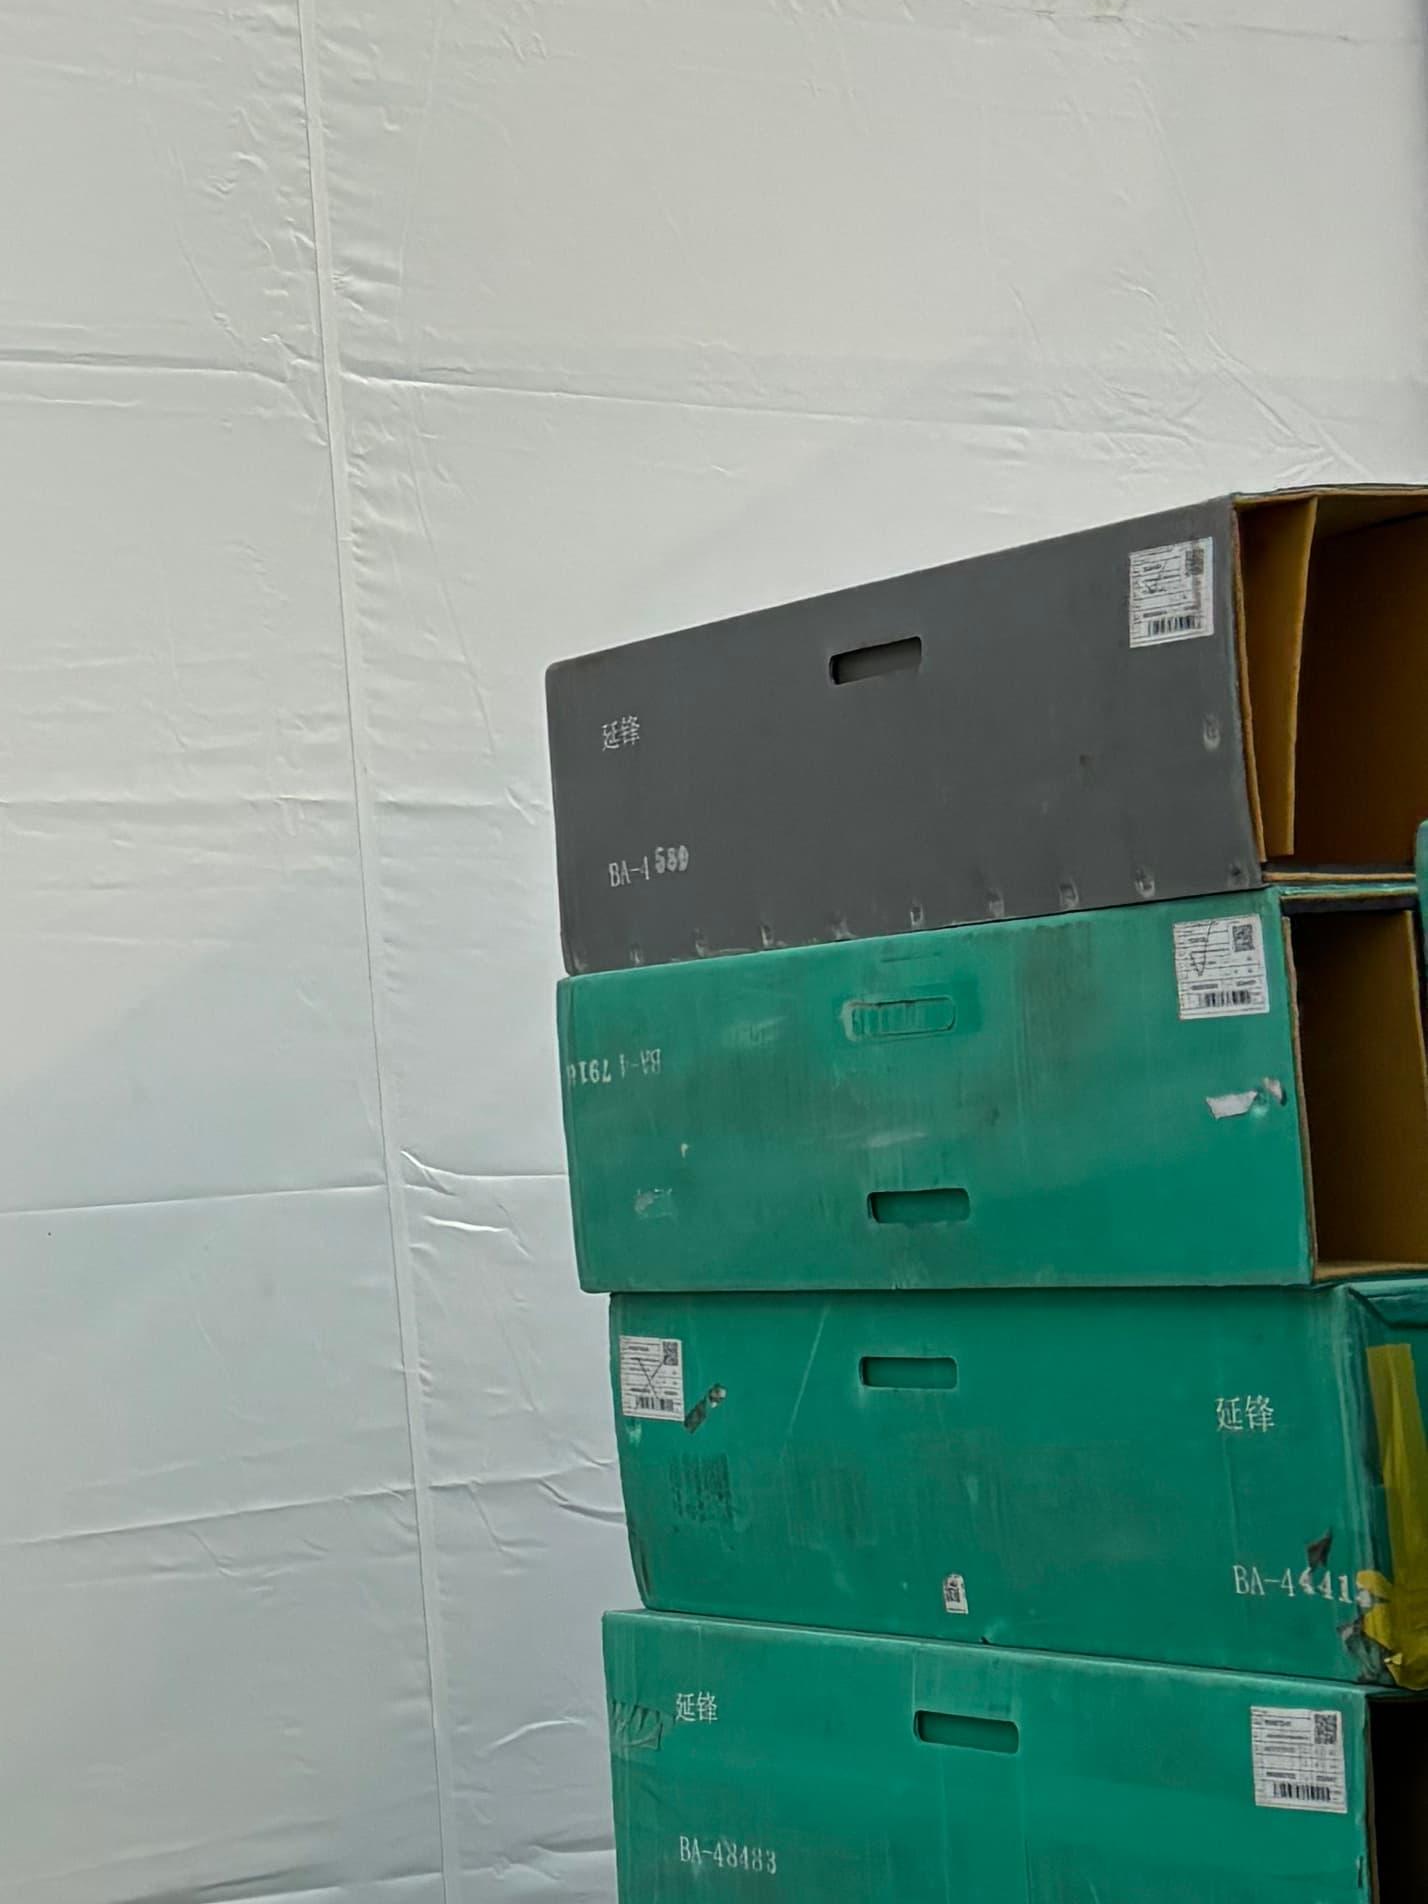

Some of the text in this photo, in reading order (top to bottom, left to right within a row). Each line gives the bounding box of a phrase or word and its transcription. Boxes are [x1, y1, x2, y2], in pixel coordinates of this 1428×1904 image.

[602, 715, 641, 752] 延锋
[1215, 1394, 1275, 1433] 延锋
[675, 1690, 719, 1726] 延锋
